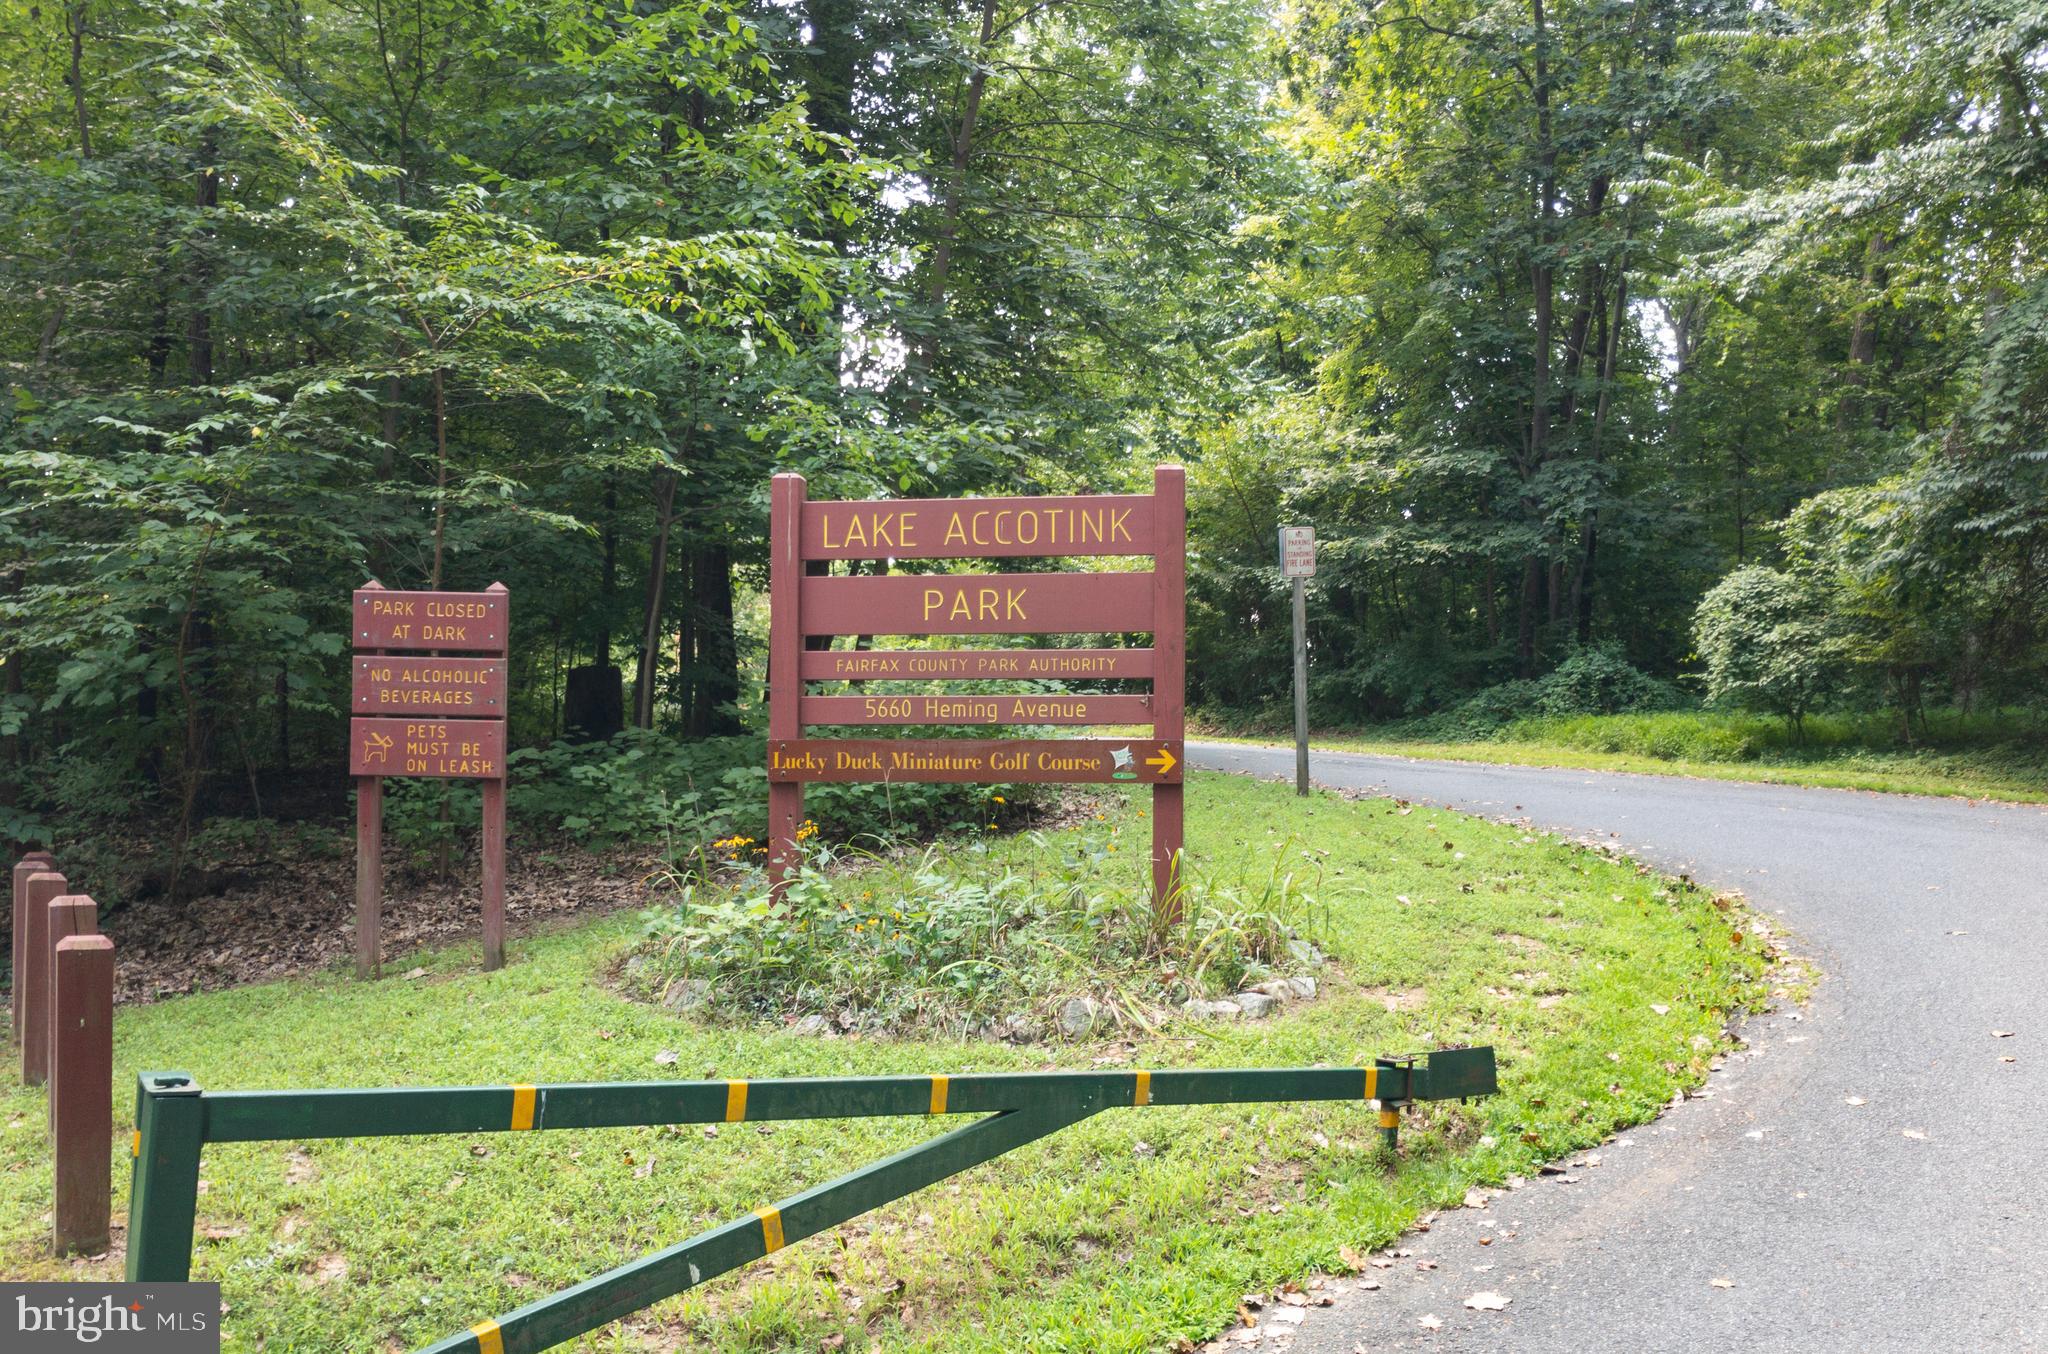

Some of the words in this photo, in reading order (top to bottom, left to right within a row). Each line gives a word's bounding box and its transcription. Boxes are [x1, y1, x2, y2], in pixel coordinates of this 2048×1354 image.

[823, 512, 918, 549] LAKE
[944, 508, 1133, 546] ACCOTINK
[1300, 559, 1313, 567] LANE
[373, 600, 415, 616] PARK
[427, 602, 486, 618] CLOSED
[923, 588, 1028, 622] PARK
[392, 625, 411, 639] AT
[423, 625, 466, 640] DARK
[836, 658, 899, 673] FAIRFAX
[909, 657, 967, 672] COUNTY
[979, 657, 1018, 672] PARK
[1029, 656, 1117, 672] AUTHORITY
[371, 669, 392, 682] NO
[402, 670, 488, 684] ALCOHOLIC
[381, 690, 473, 705] BEVERAGES
[865, 699, 912, 719] 5660
[925, 699, 998, 723] Heming
[1012, 699, 1087, 718] Avenue
[407, 725, 447, 738] PETS
[407, 742, 449, 755] MUST
[462, 743, 481, 756] BE
[407, 759, 427, 772] ON
[440, 760, 492, 773] LEASH
[773, 751, 828, 775] Lucky
[836, 751, 883, 770] Duck
[891, 751, 982, 771] Miniature
[990, 751, 1029, 771] Golf
[1039, 751, 1101, 771] Course
